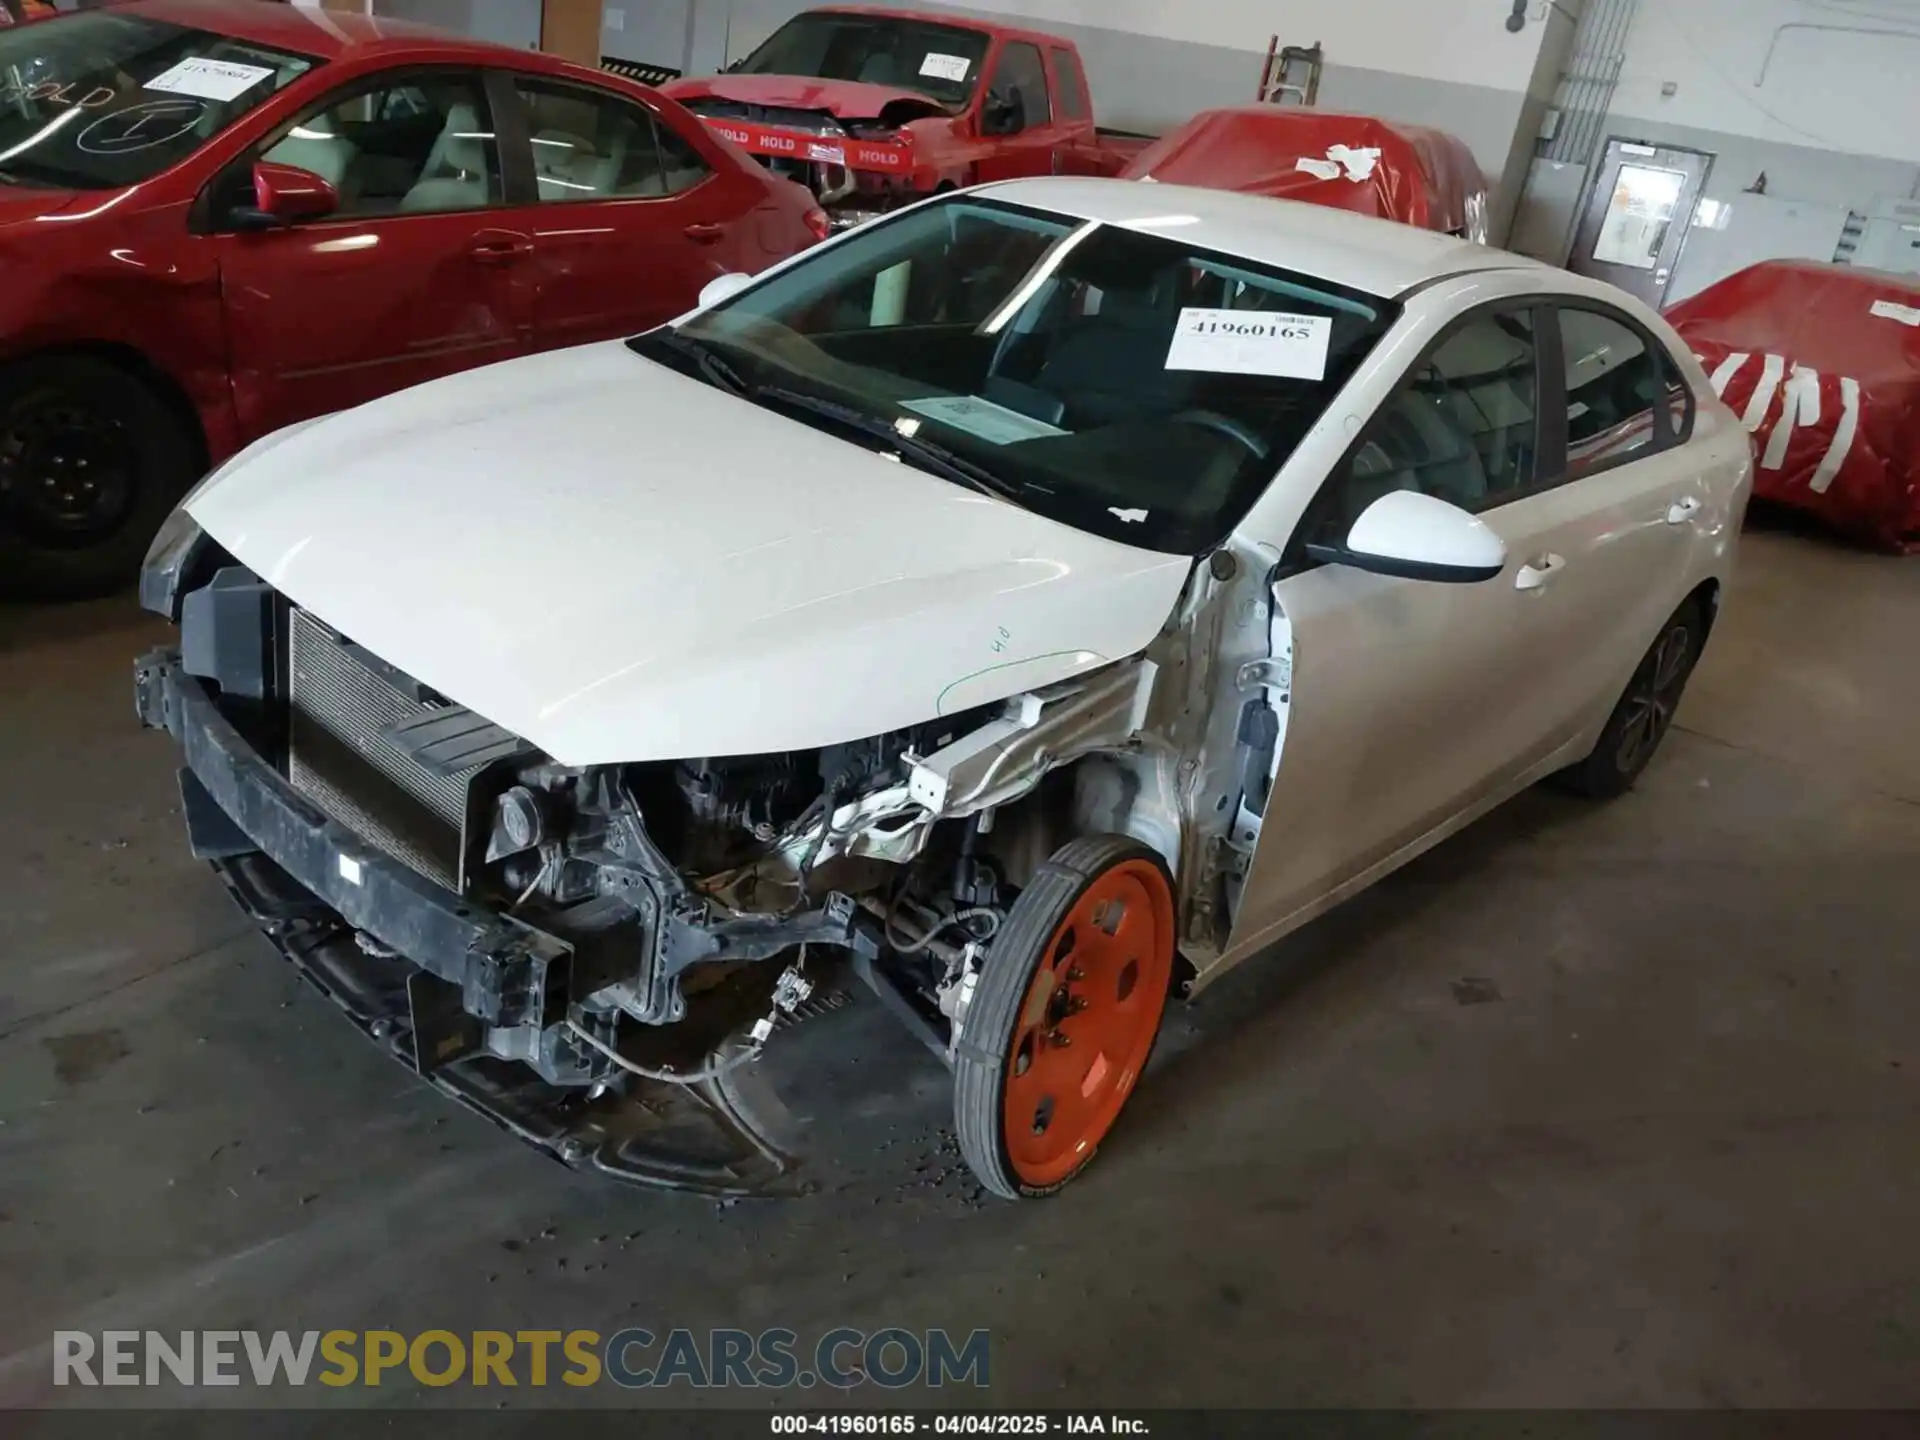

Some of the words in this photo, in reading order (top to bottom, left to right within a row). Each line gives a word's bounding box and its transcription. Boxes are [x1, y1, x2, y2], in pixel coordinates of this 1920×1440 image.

[760, 135, 795, 151] HOLD
[859, 150, 899, 165] HOLD
[1191, 321, 1311, 340] 41960165
